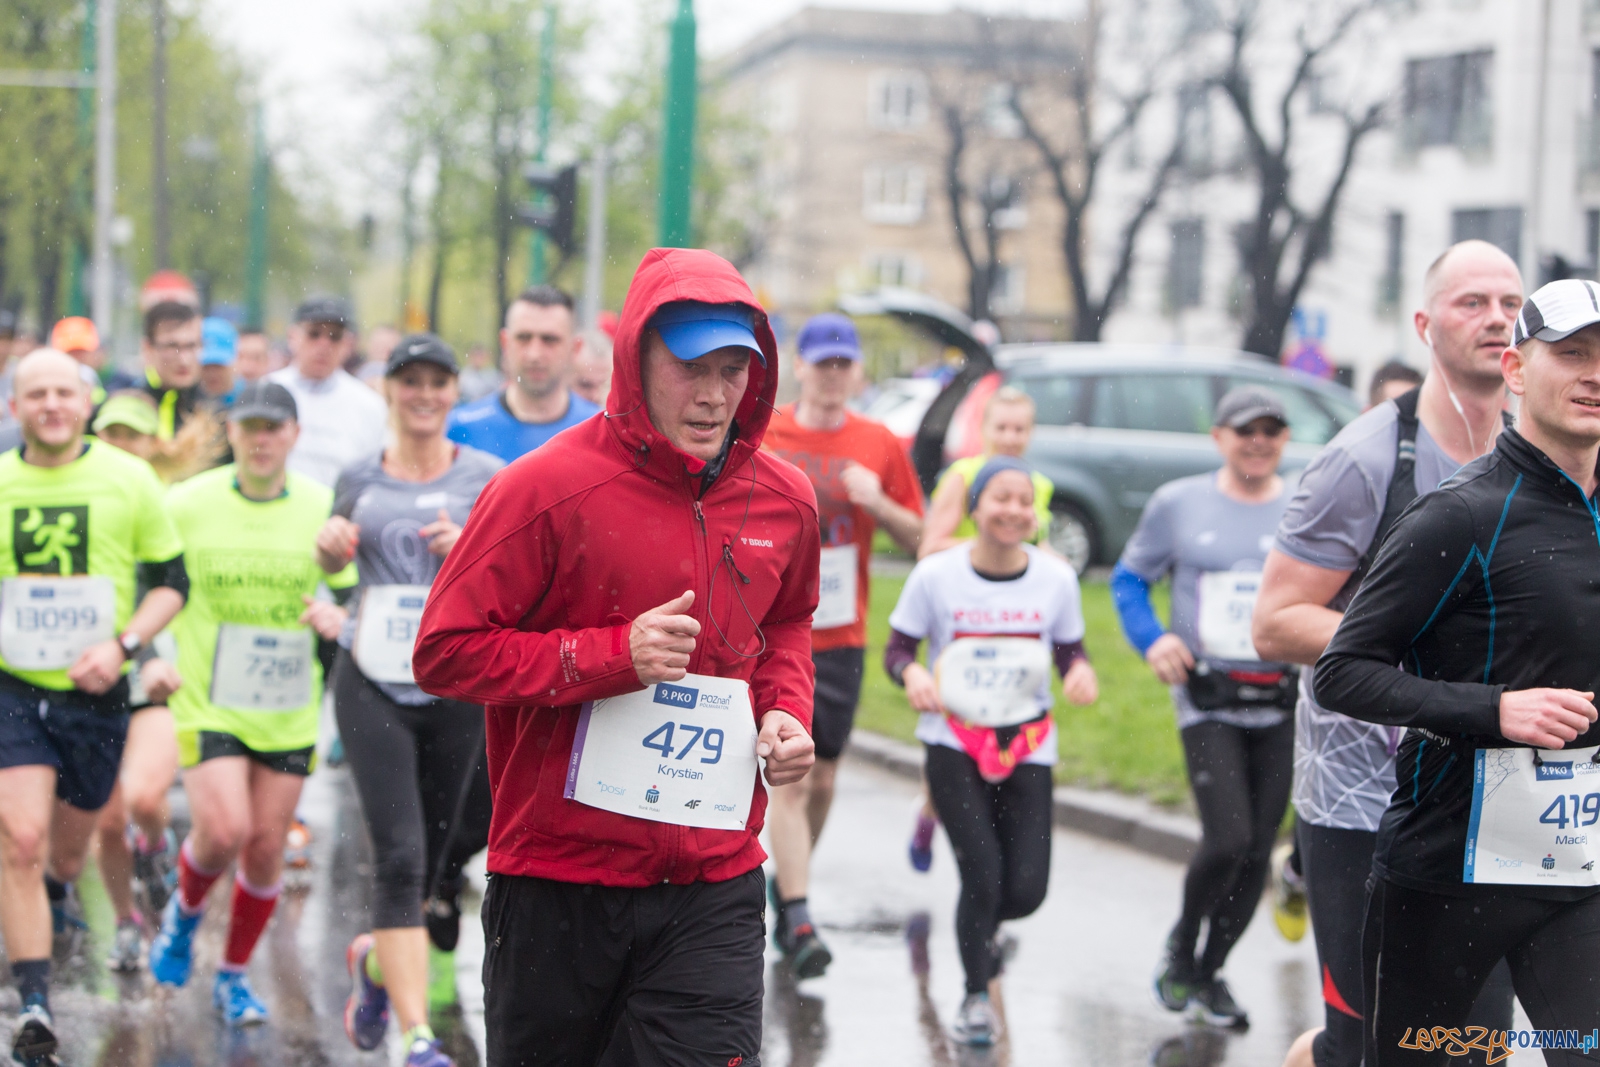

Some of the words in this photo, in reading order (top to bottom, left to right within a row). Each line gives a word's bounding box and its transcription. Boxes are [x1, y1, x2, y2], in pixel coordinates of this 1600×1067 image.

[748, 538, 773, 548] BRUGI
[16, 606, 98, 631] 13099
[954, 610, 1042, 624] POLSKA
[670, 691, 692, 702] PKO
[642, 721, 725, 764] 479
[657, 764, 704, 780] Krystian
[600, 782, 626, 796] posir
[684, 800, 702, 809] 4F
[1539, 792, 1600, 829] 419
[1556, 834, 1587, 845] Maciej
[1498, 858, 1523, 868] posir
[1581, 860, 1594, 871] 4F
